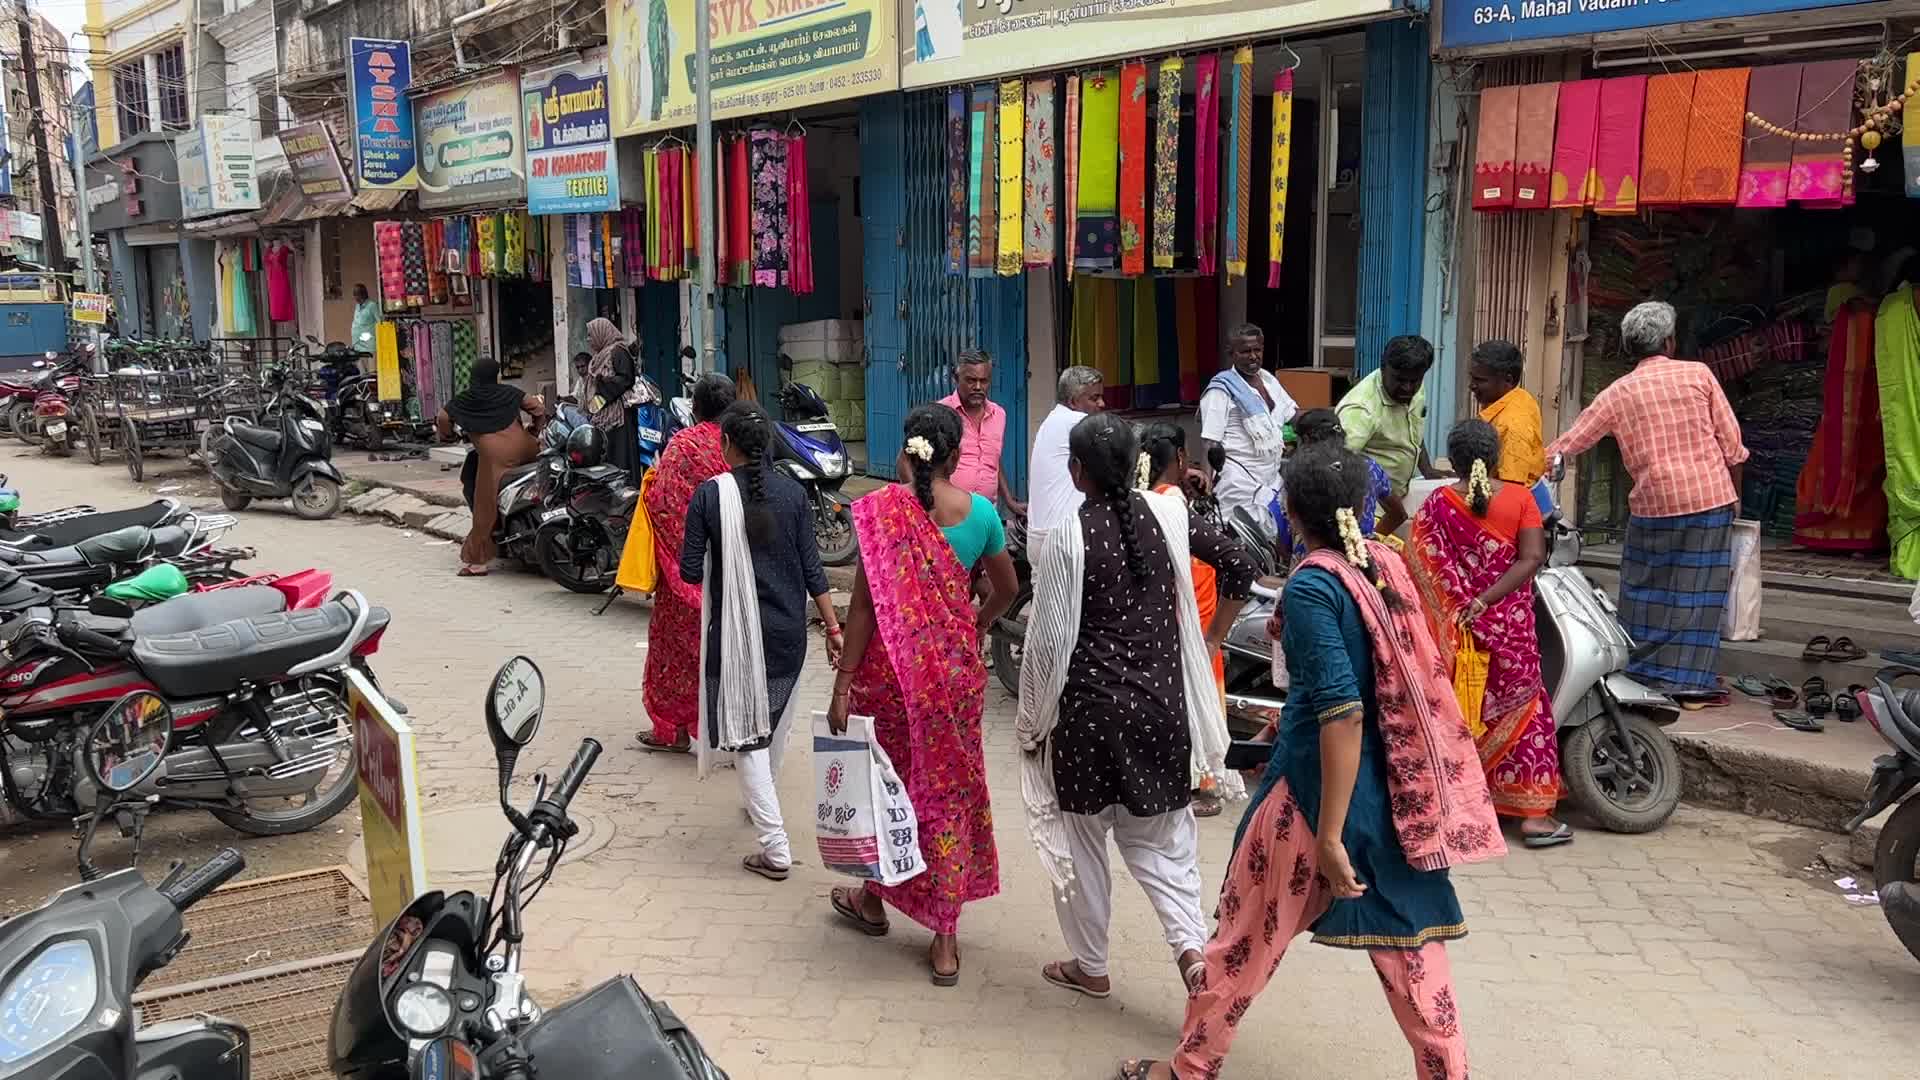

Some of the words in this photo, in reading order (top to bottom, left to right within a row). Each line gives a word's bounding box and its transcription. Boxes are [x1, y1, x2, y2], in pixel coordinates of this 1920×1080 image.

[1474, 5, 1516, 25] 63-A,
[1521, 0, 1571, 19] Mahal
[532, 158, 548, 177] SRI
[551, 151, 608, 176] KAMATCHI
